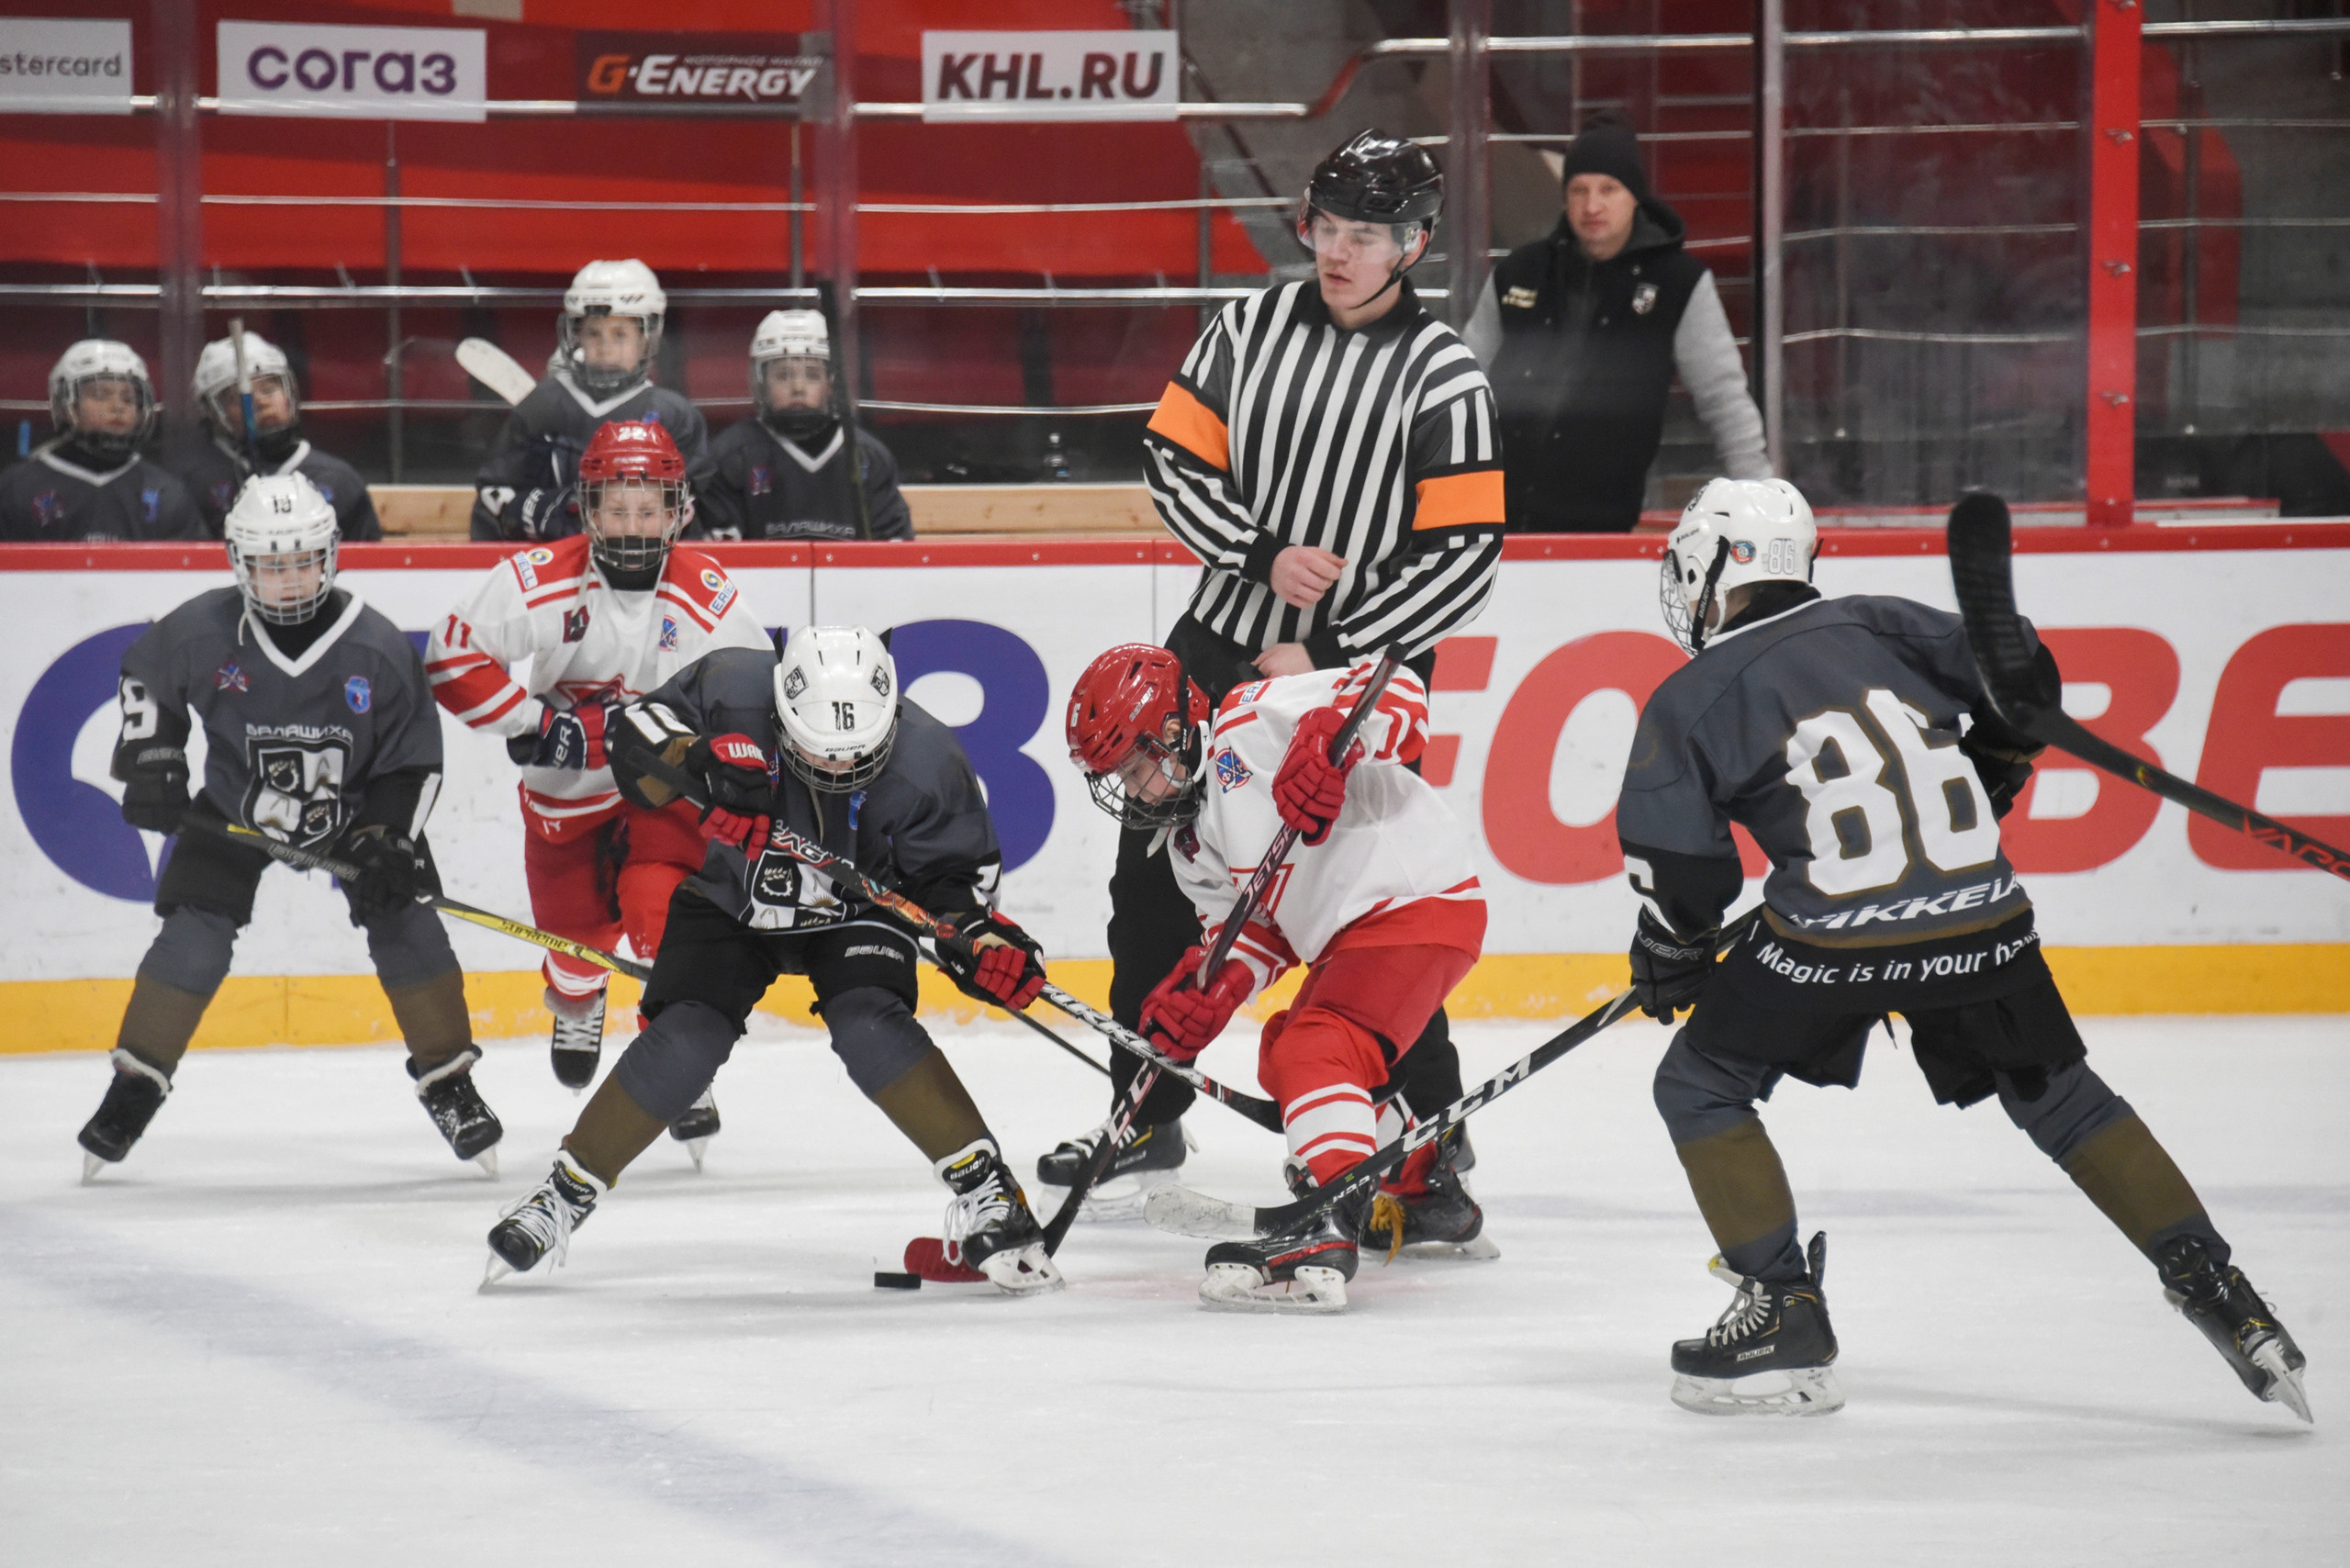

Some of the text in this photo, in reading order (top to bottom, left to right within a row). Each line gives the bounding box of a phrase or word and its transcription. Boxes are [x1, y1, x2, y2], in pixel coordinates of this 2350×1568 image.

[937, 51, 1164, 99] KHL.RU
[1698, 583, 1713, 620] BAUER
[831, 700, 856, 731] 16
[824, 744, 867, 753] BAUER
[1785, 689, 2002, 896] 86
[1243, 823, 1292, 912] JETSP
[1755, 941, 1841, 984] Magic
[1848, 962, 1875, 983] is
[1882, 958, 1917, 981] in
[1919, 950, 1988, 983] your
[1107, 1058, 1154, 1146] CC
[1402, 1052, 1532, 1153] CCM
[558, 1167, 590, 1194] BAUER
[950, 1156, 985, 1181] BAUER
